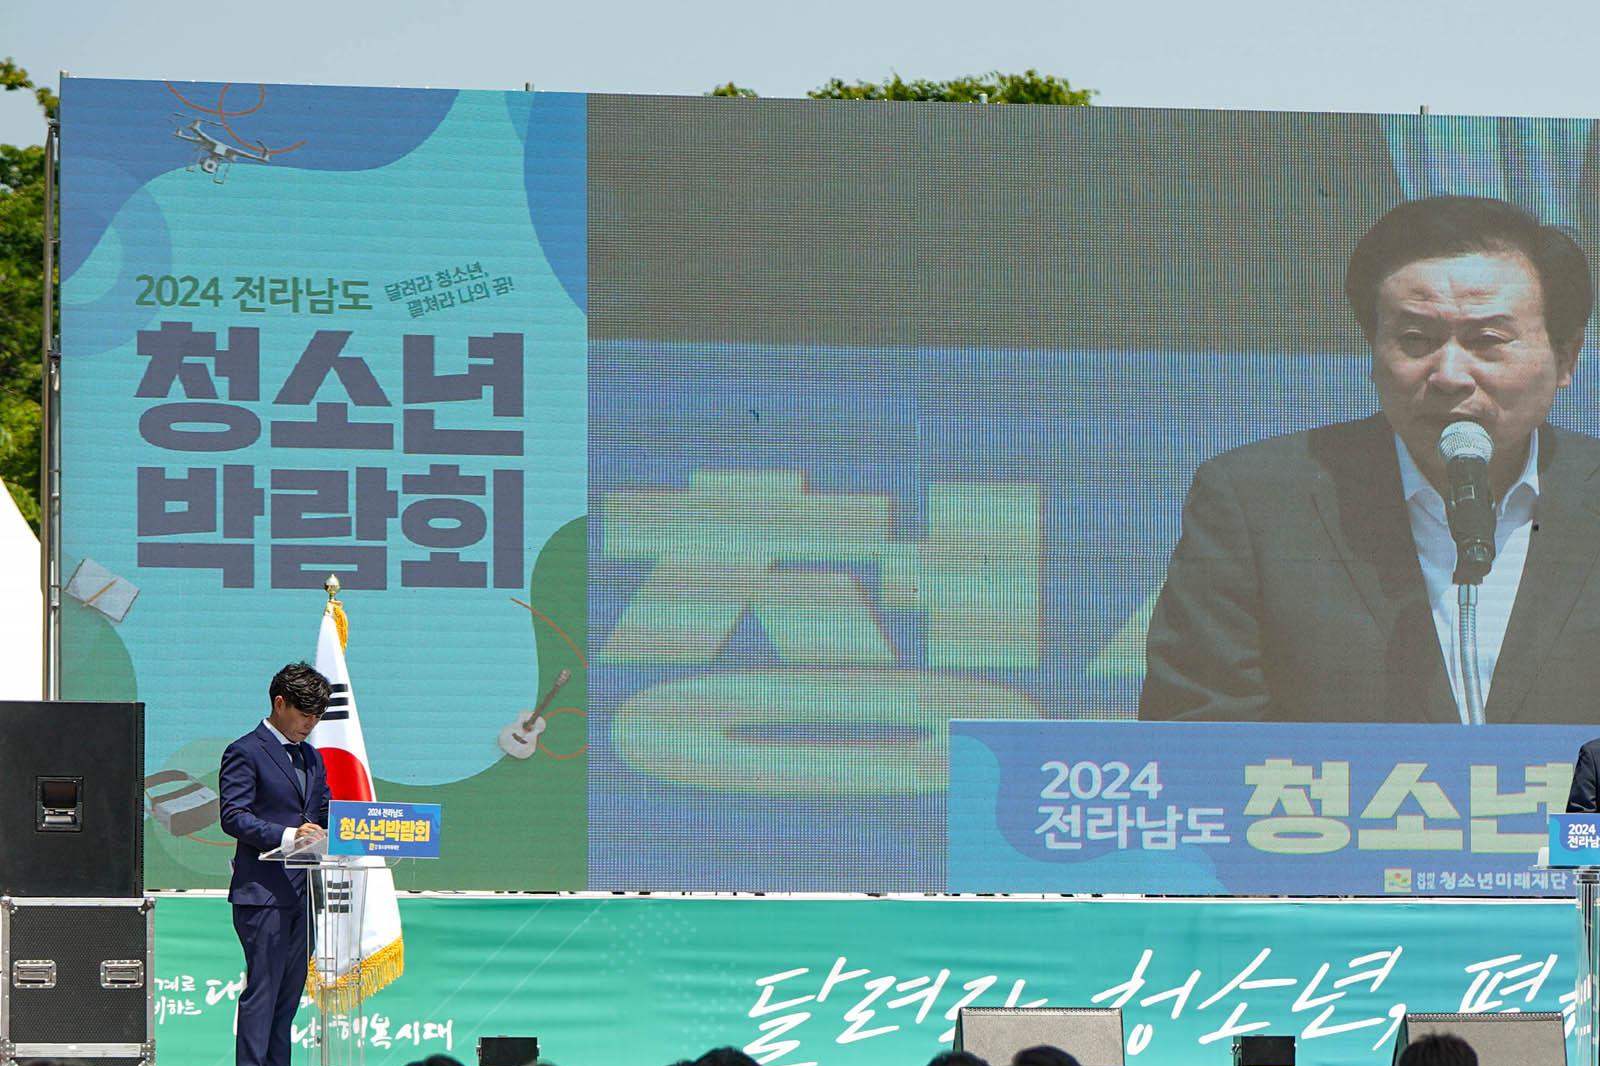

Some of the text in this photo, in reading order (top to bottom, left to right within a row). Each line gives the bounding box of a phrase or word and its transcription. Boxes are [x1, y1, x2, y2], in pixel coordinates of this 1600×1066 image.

[136, 275, 374, 315] 2024 전라남도
[384, 261, 489, 302] 달려라 청소년,
[406, 276, 515, 319] 펼쳐라 나의 꿈!
[134, 321, 524, 456] 청소년
[137, 464, 524, 591] 박람회
[1040, 761, 1163, 800] 2024
[340, 817, 431, 842] 청소년박람회
[1035, 805, 1231, 850] 전라남도
[1568, 823, 1596, 835] 2024
[1439, 871, 1569, 891] 청소년미래재단
[154, 975, 196, 993] 계로
